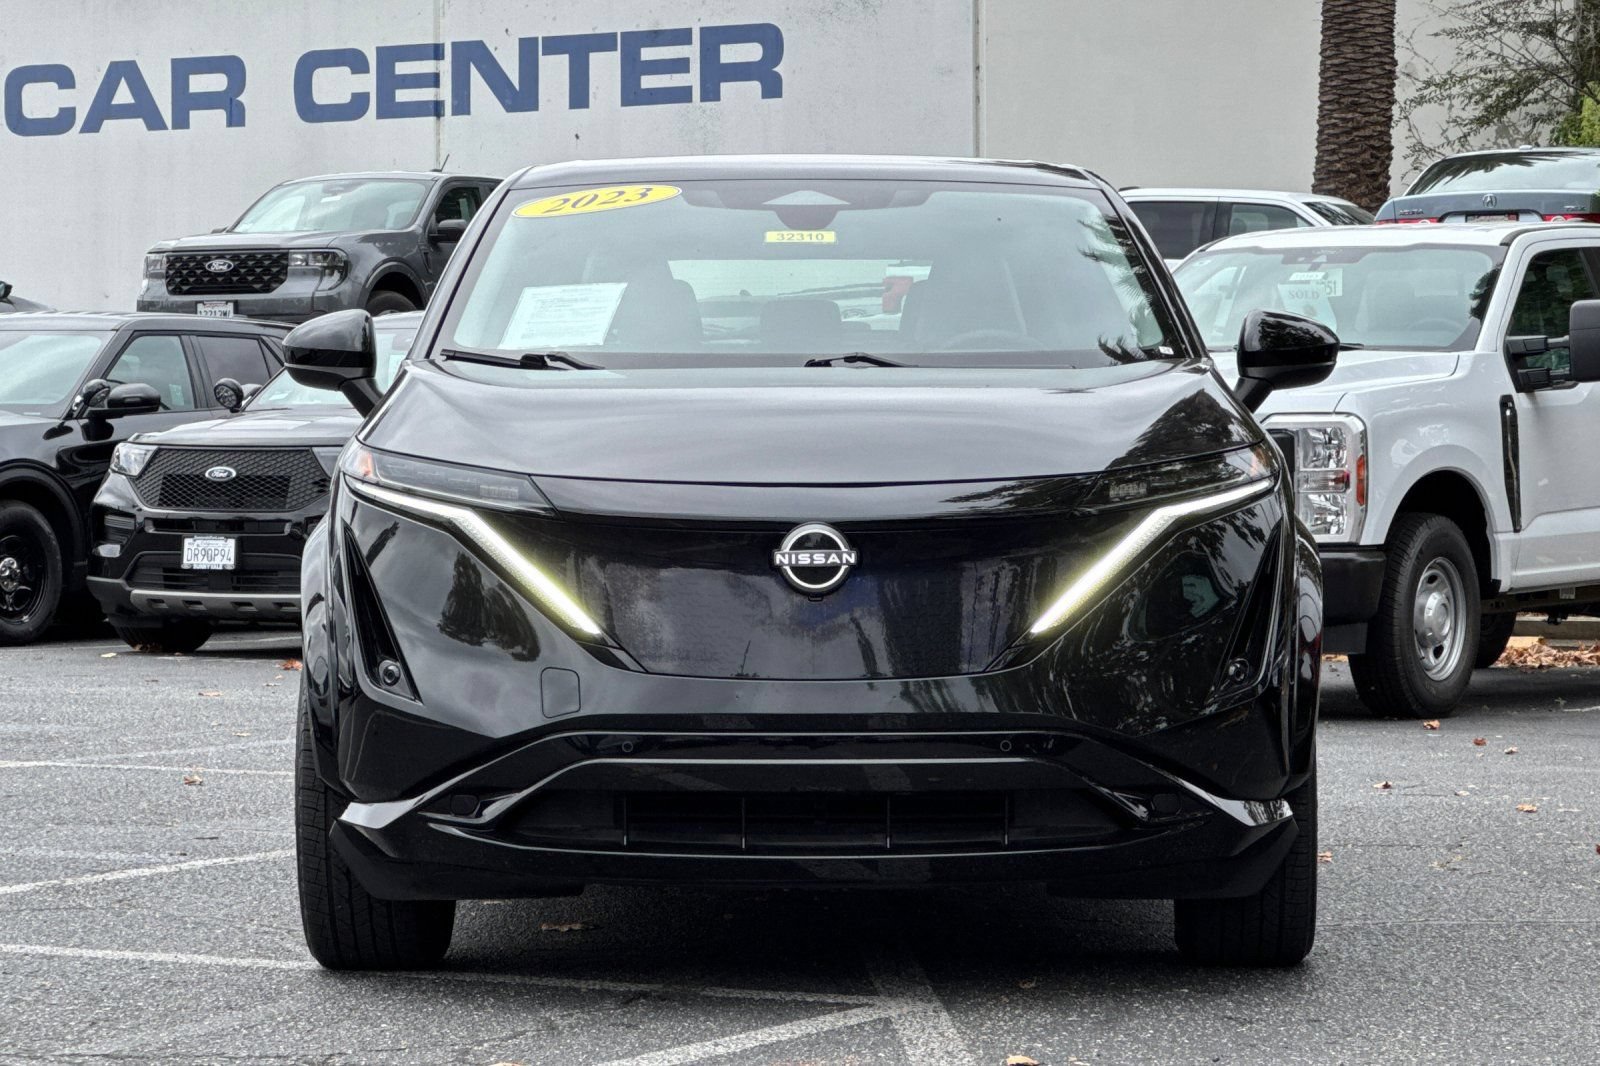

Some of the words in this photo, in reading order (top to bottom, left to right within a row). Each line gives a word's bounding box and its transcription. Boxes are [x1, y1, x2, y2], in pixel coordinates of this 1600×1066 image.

[4, 55, 246, 137] CAR
[293, 22, 784, 124] CENTER
[542, 187, 653, 213] 2023
[776, 232, 825, 241] 32310
[1288, 289, 1320, 300] SOLD
[186, 547, 232, 562] DR90P94
[775, 553, 855, 564] NISSAN
